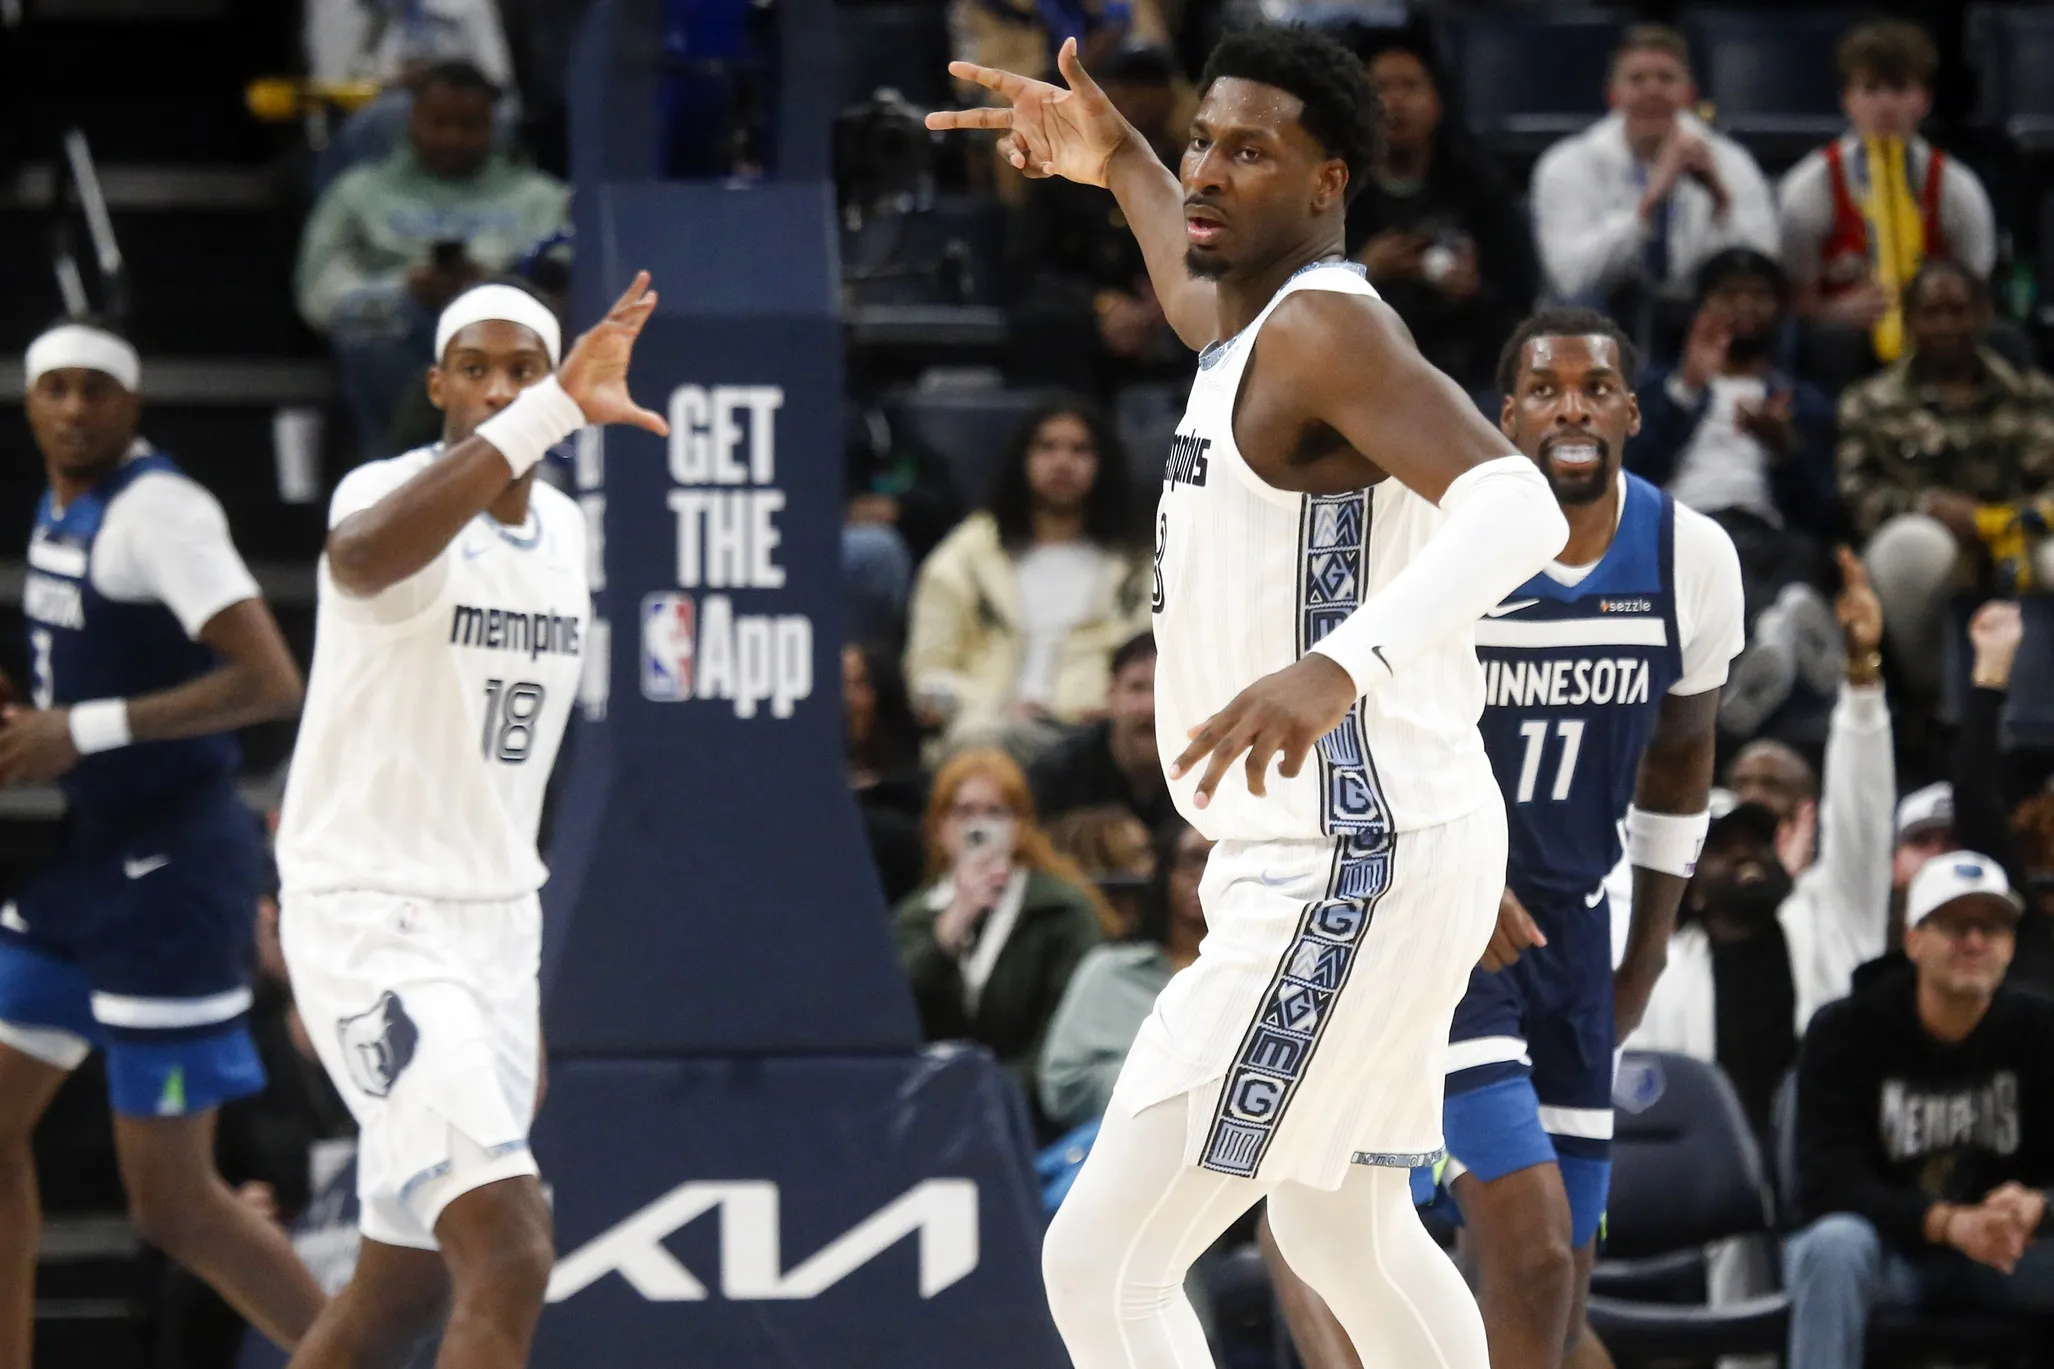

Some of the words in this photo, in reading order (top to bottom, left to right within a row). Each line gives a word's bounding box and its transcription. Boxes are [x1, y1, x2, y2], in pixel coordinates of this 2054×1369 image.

[668, 384, 784, 485] GET
[666, 488, 786, 588] THE
[450, 605, 578, 662] memphis
[1609, 599, 1651, 612] sezzle
[696, 593, 813, 719] App
[1482, 658, 1649, 706] INNESOTA
[478, 678, 545, 763] 18
[1515, 718, 1586, 804] 11
